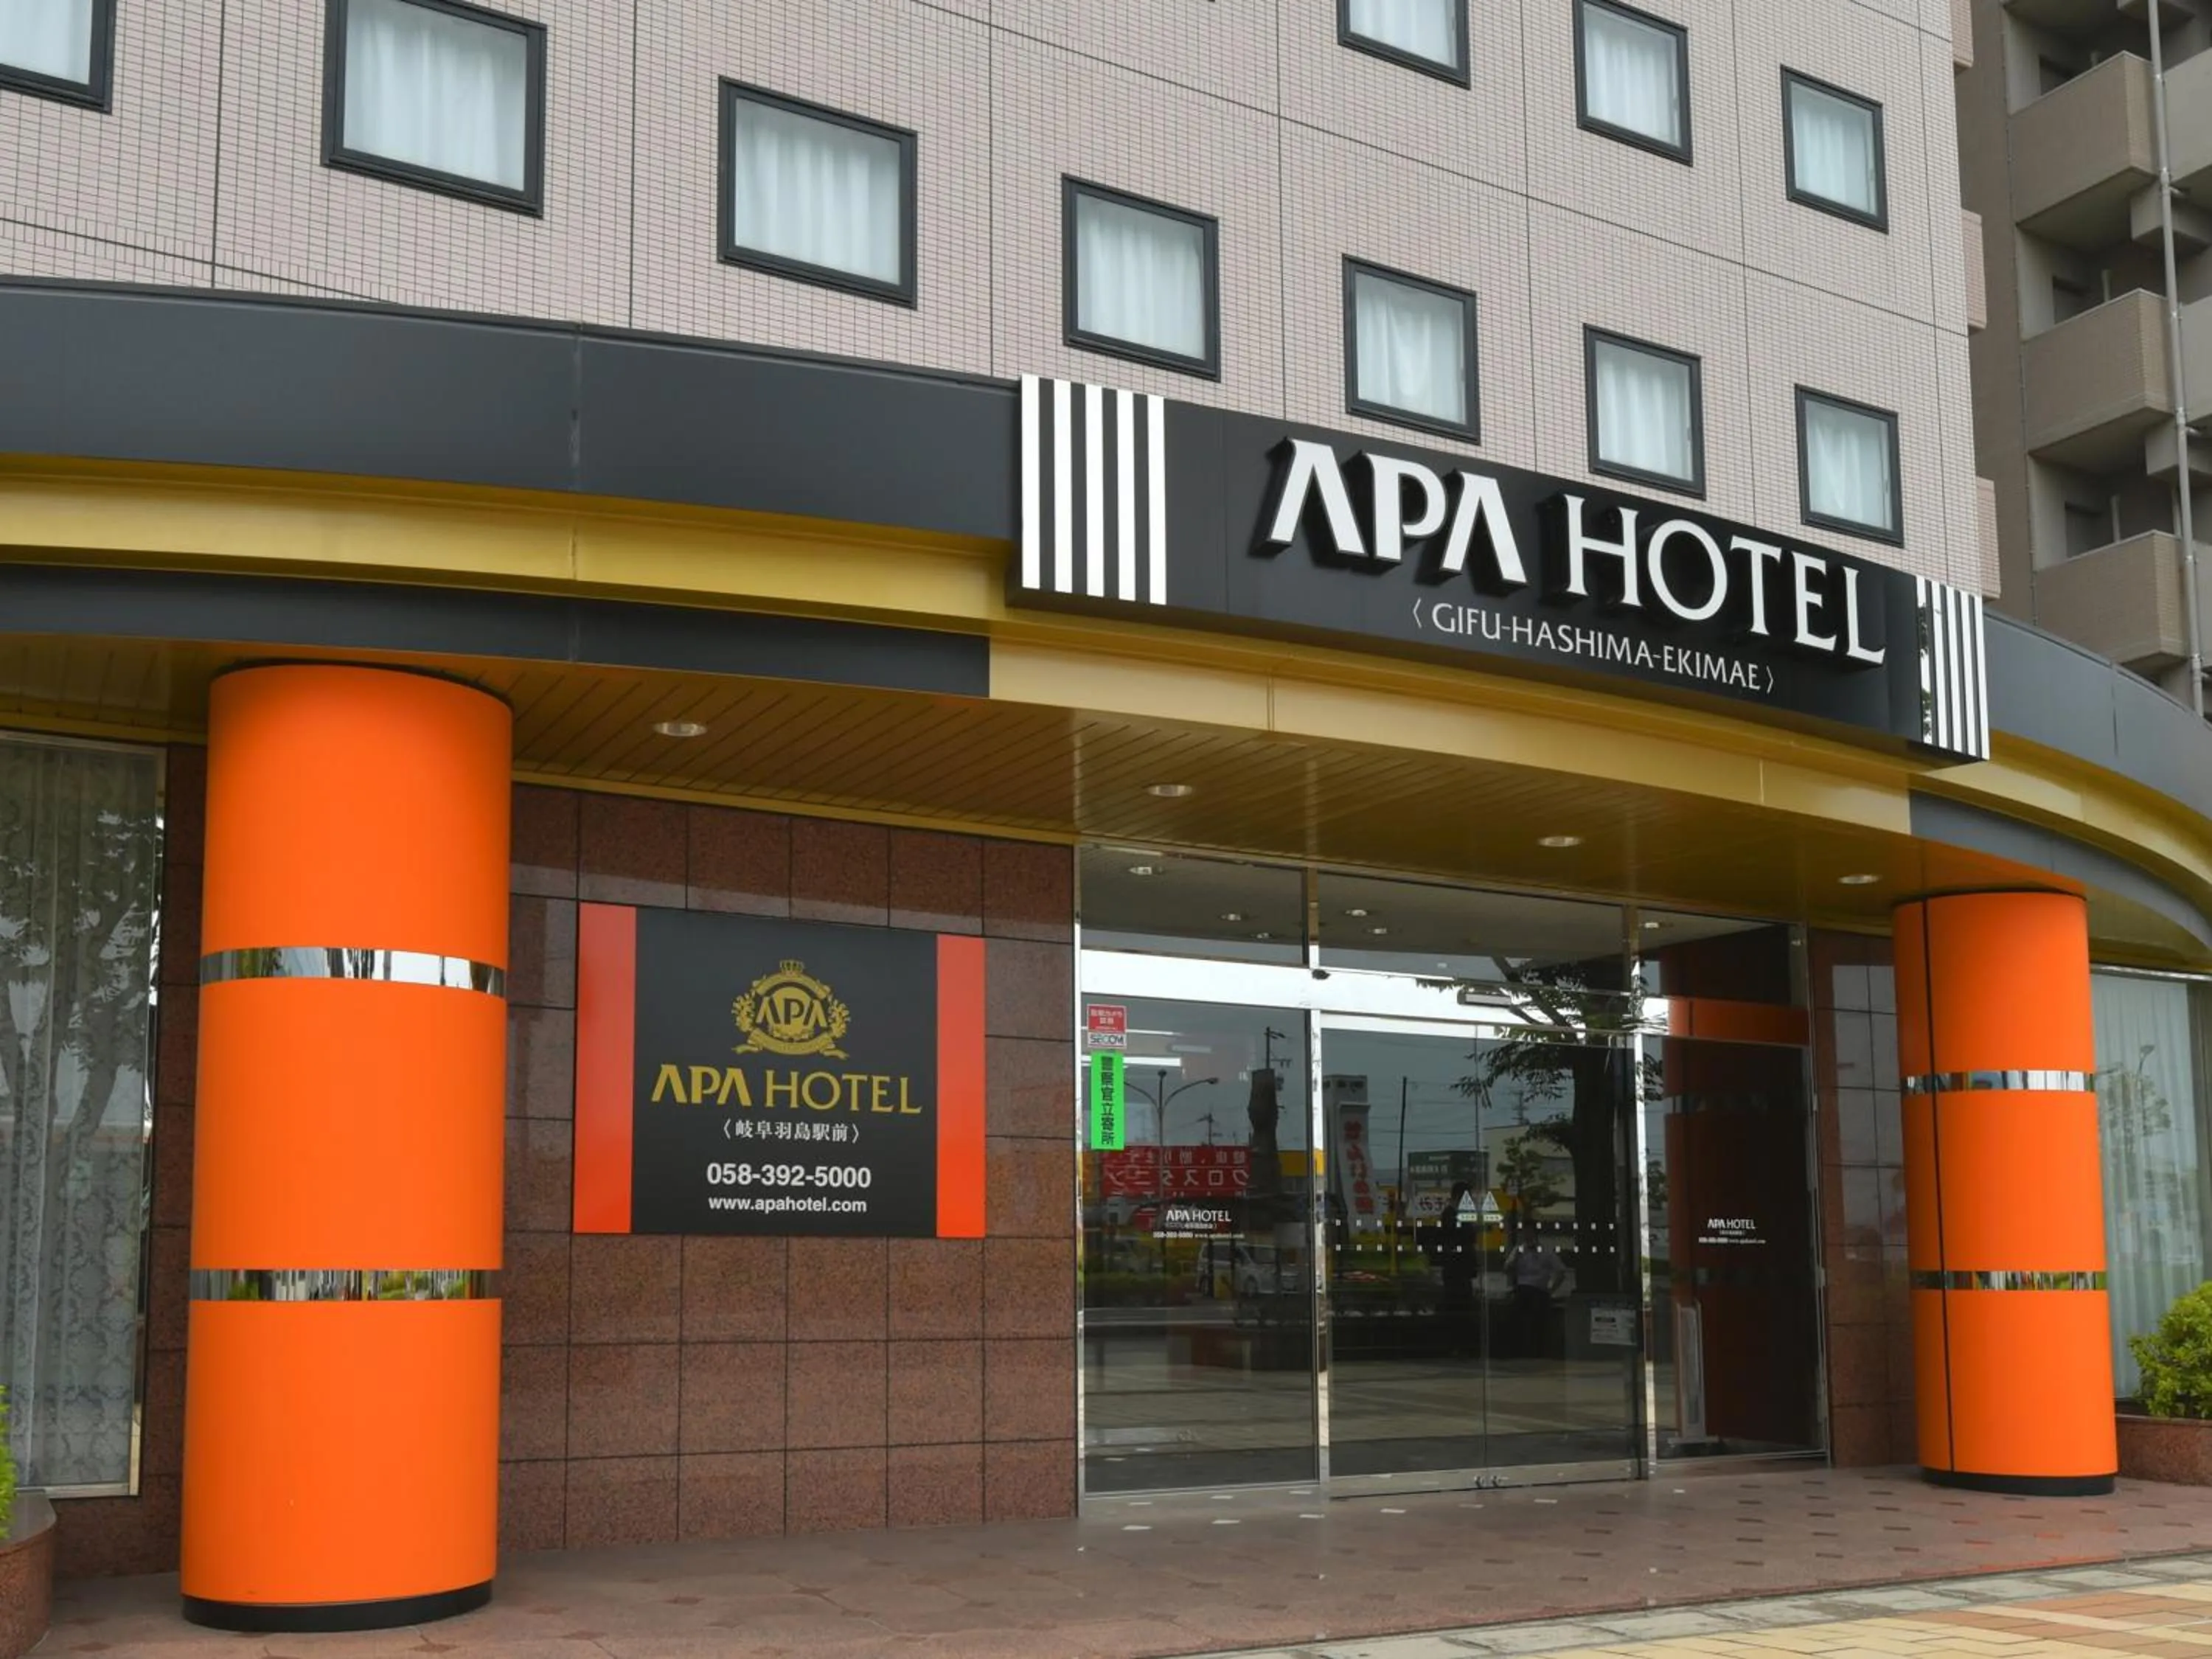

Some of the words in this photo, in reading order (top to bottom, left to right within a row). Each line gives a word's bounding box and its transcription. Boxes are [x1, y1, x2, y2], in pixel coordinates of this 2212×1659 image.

[1267, 438, 1528, 585] APA
[1563, 494, 1886, 667] HOTEL
[755, 995, 828, 1028] APA
[651, 1064, 752, 1107] APA
[765, 1069, 922, 1114] HOTEL
[706, 1162, 872, 1189] 058-392-5000
[708, 1196, 868, 1214] www.apahotel.com
[1166, 1210, 1190, 1222] APA
[1192, 1210, 1232, 1222] HOTEL
[1708, 1219, 1725, 1228] APA
[1726, 1219, 1757, 1229] HOTEL
